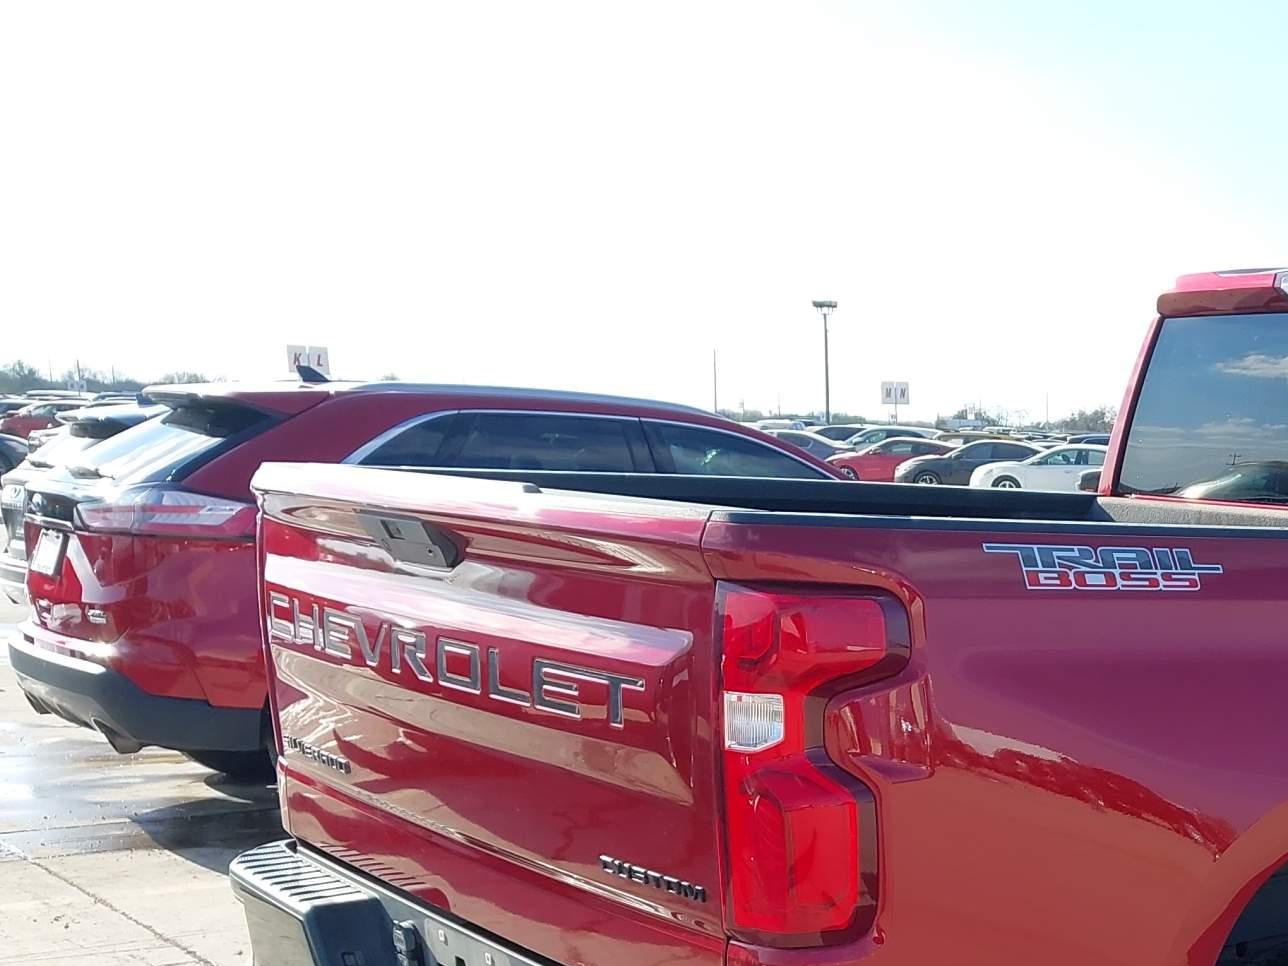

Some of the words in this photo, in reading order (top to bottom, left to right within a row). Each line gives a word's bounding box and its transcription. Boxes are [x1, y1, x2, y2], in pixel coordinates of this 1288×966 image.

[293, 352, 302, 366] K
[317, 354, 323, 367] L
[982, 543, 1223, 573] TRAIL
[1024, 568, 1200, 591] BOSS
[269, 590, 646, 730] CHEVROLET
[598, 854, 706, 903] CUSTOM
